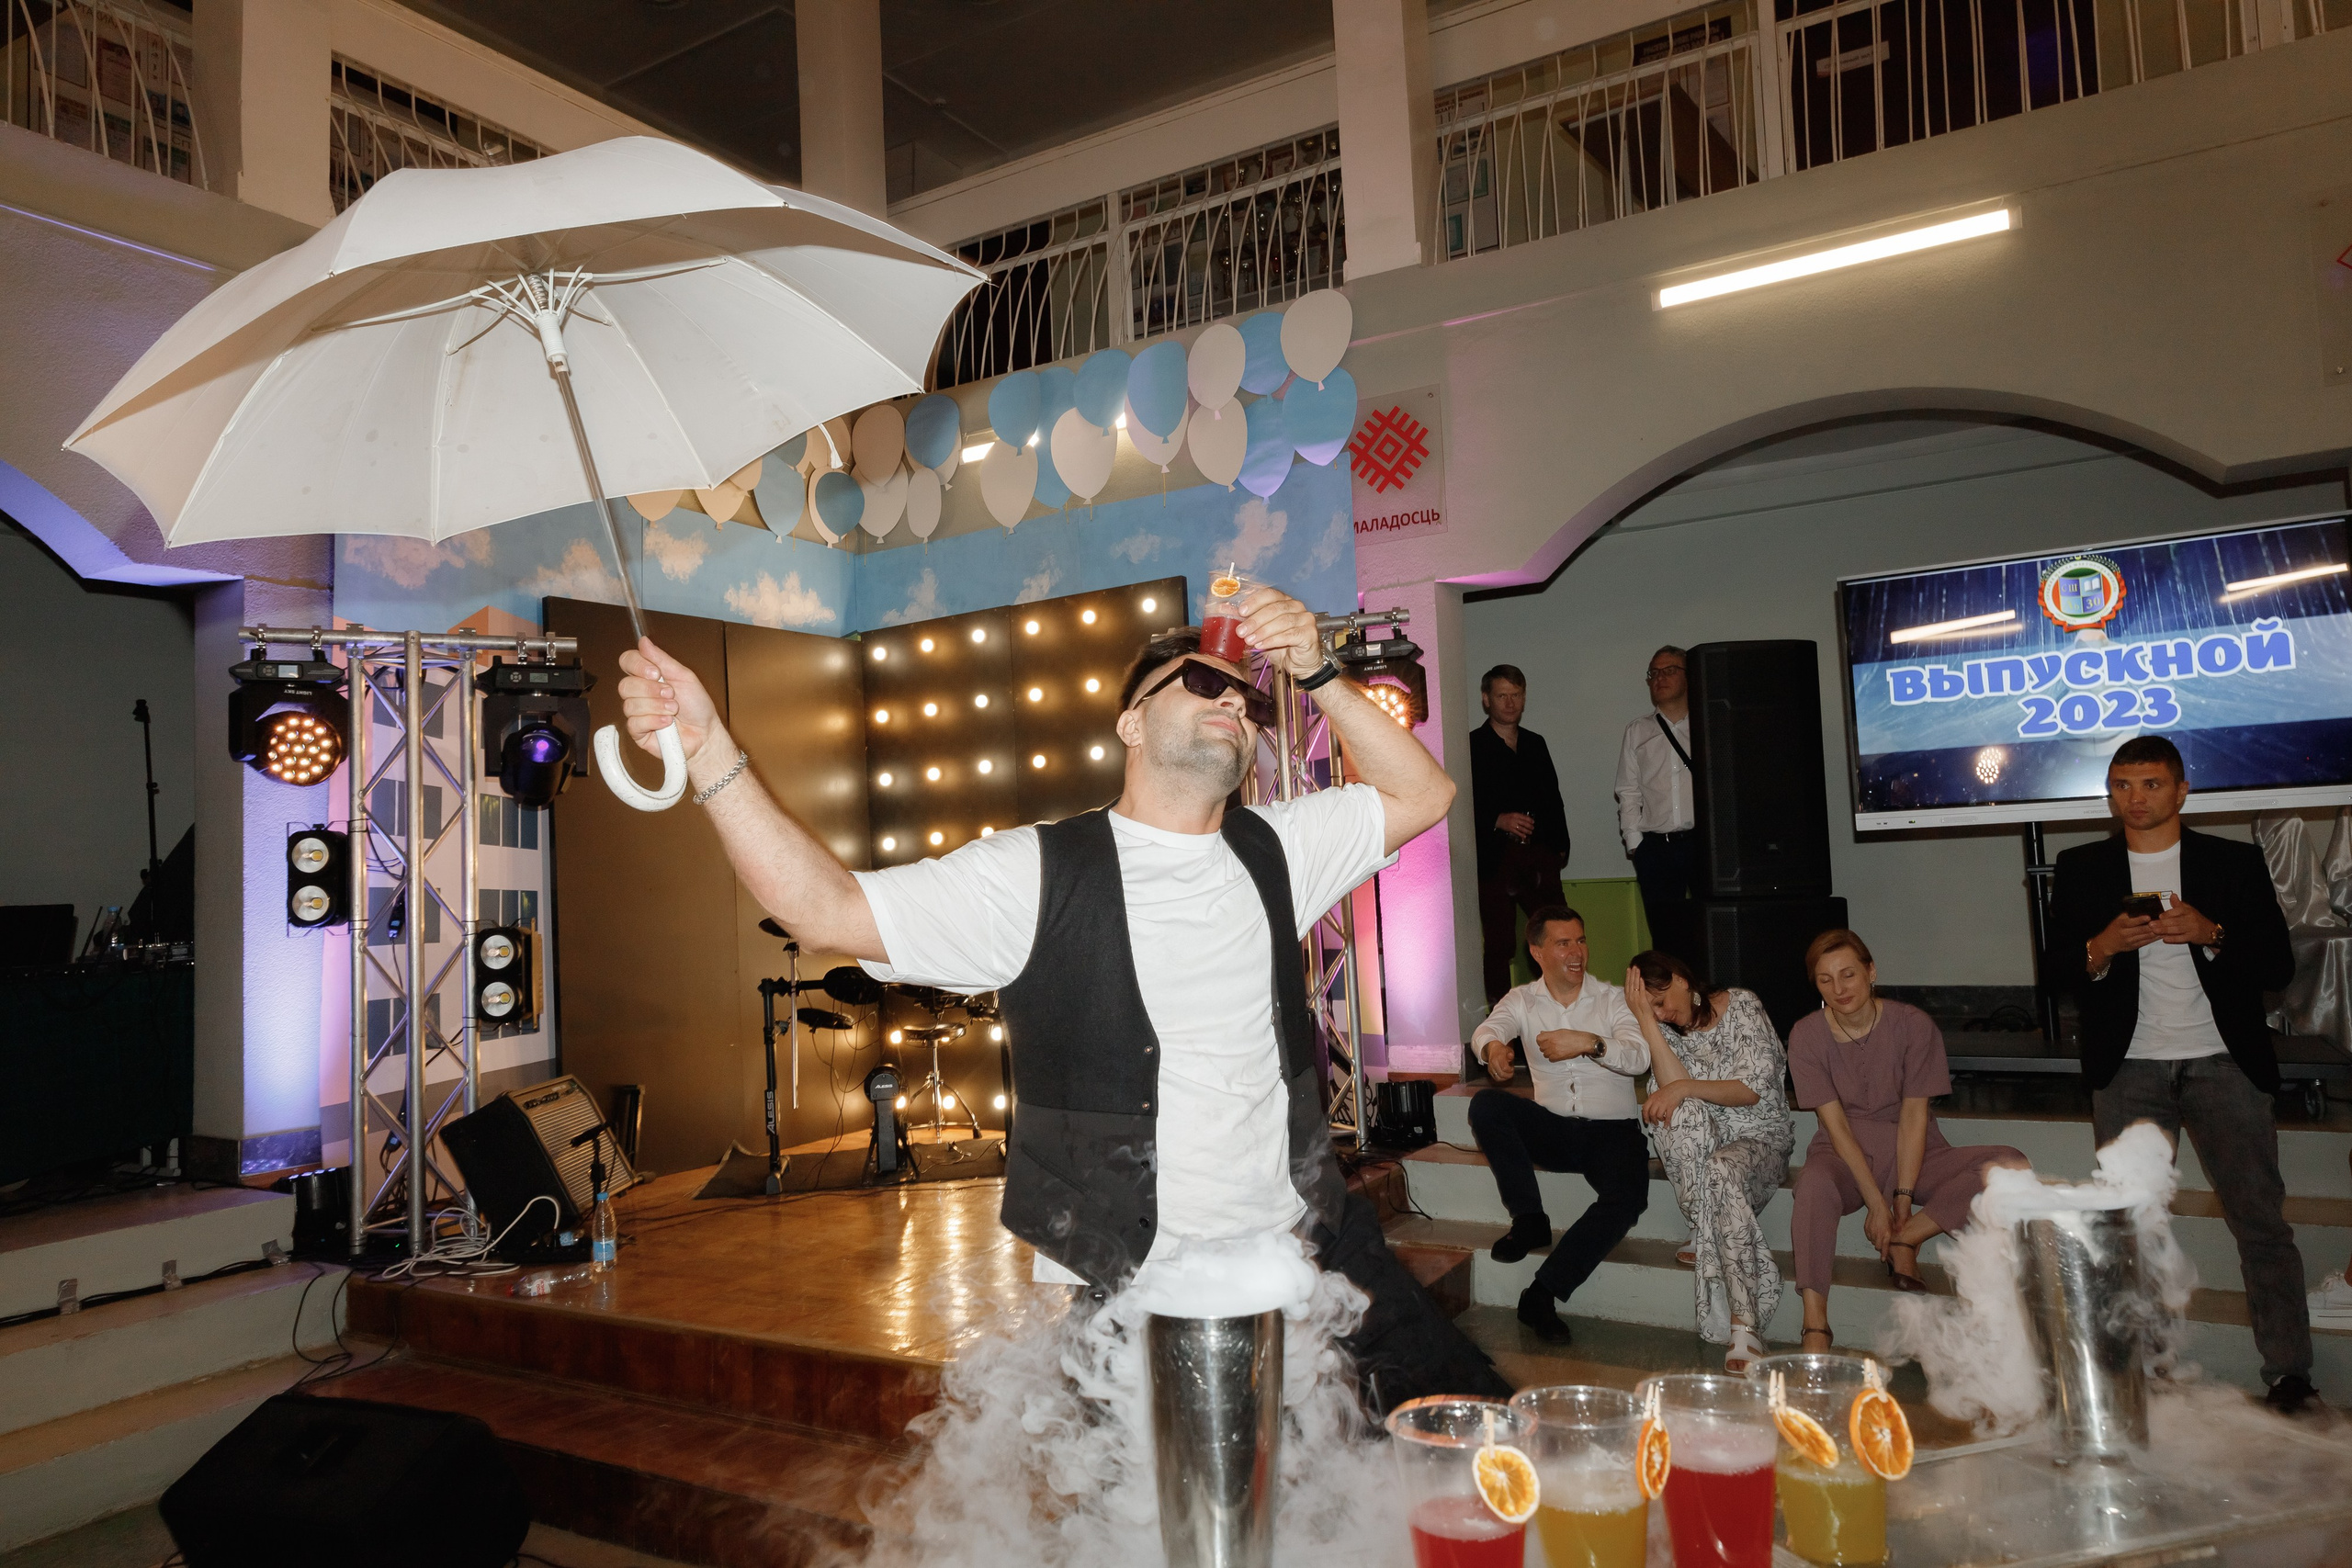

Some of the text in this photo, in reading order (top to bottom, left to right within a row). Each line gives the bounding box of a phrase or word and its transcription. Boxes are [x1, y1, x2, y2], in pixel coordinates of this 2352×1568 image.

[2086, 597, 2101, 609] 30
[1888, 617, 2295, 706] ВЫПУСКНОЙ
[2018, 685, 2182, 738] 2023
[766, 1090, 775, 1134] ALESIS
